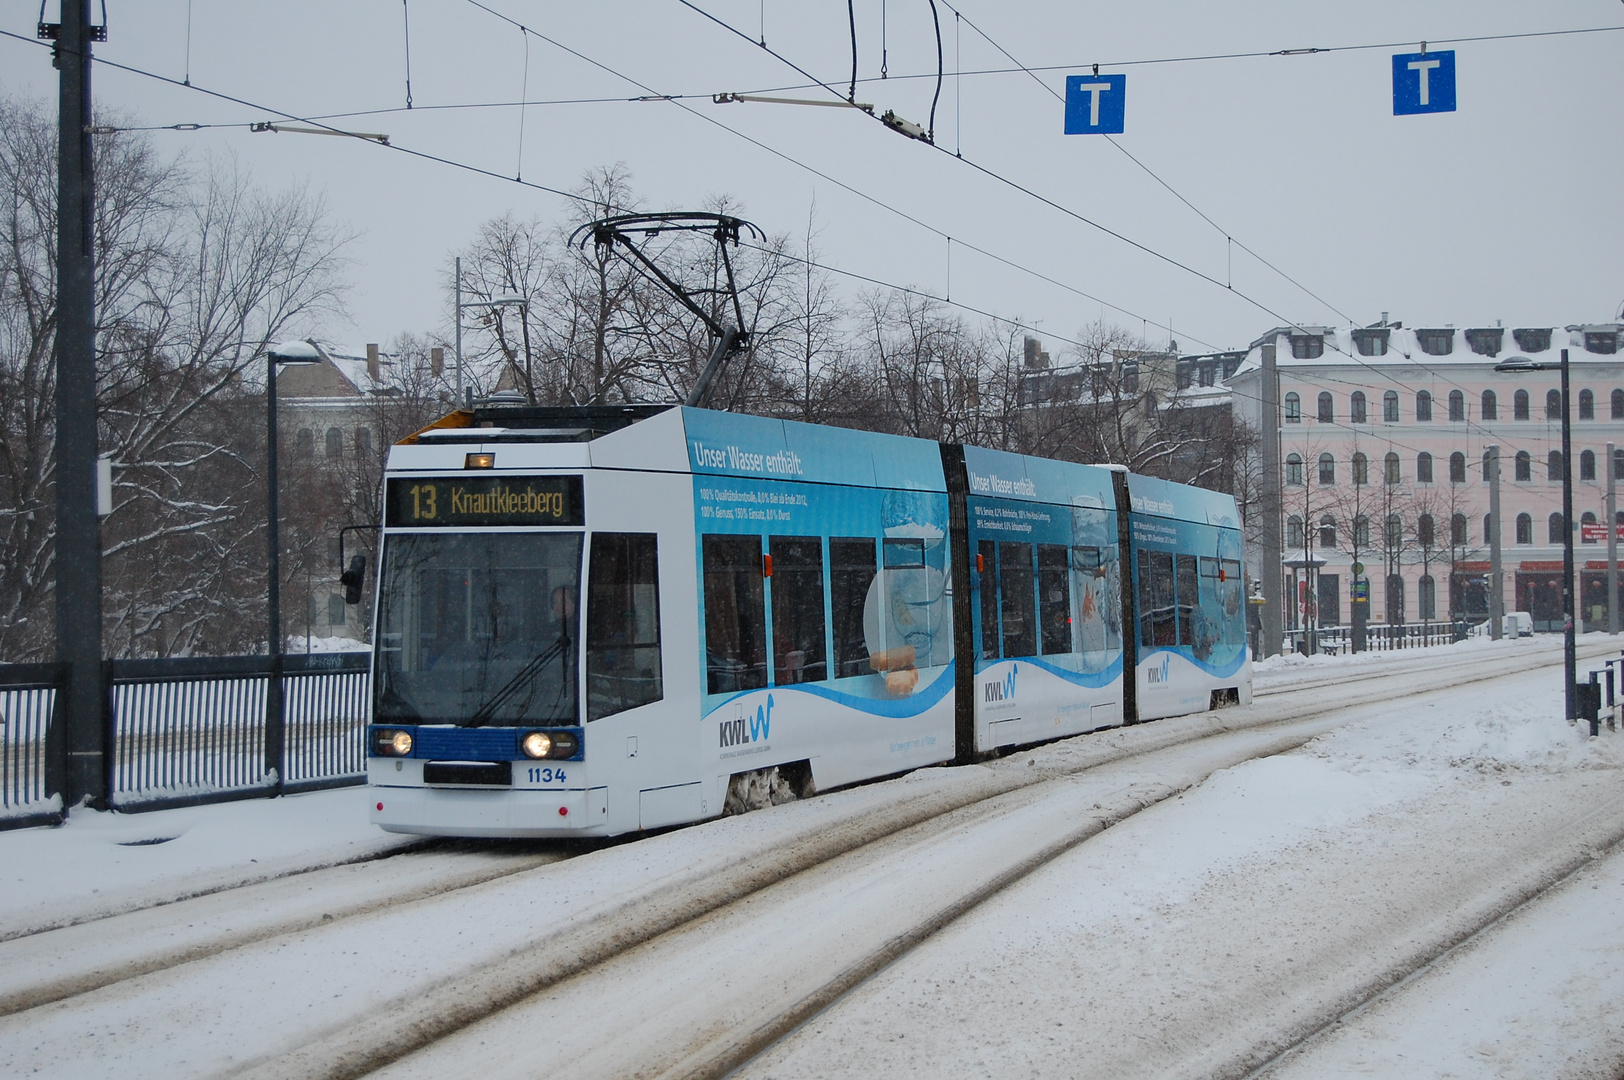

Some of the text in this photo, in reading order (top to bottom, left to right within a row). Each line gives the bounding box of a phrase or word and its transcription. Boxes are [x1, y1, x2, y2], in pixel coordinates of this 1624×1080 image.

[1408, 60, 1440, 105] T
[1080, 83, 1111, 126] T
[694, 442, 804, 475] Unser Wasser enthält:
[700, 488, 714, 500] 100%
[970, 471, 990, 492] Unser
[990, 474, 1012, 494] Wasser
[409, 485, 563, 519] 13 Knautkleeberg
[701, 506, 715, 518] 100%
[715, 506, 734, 520] Genuss,
[734, 507, 748, 519] 150%
[778, 509, 791, 521] Durst
[1148, 668, 1160, 684] KWL
[985, 682, 1003, 702] KWL
[720, 719, 749, 748] KWL
[528, 768, 567, 783] 1134
